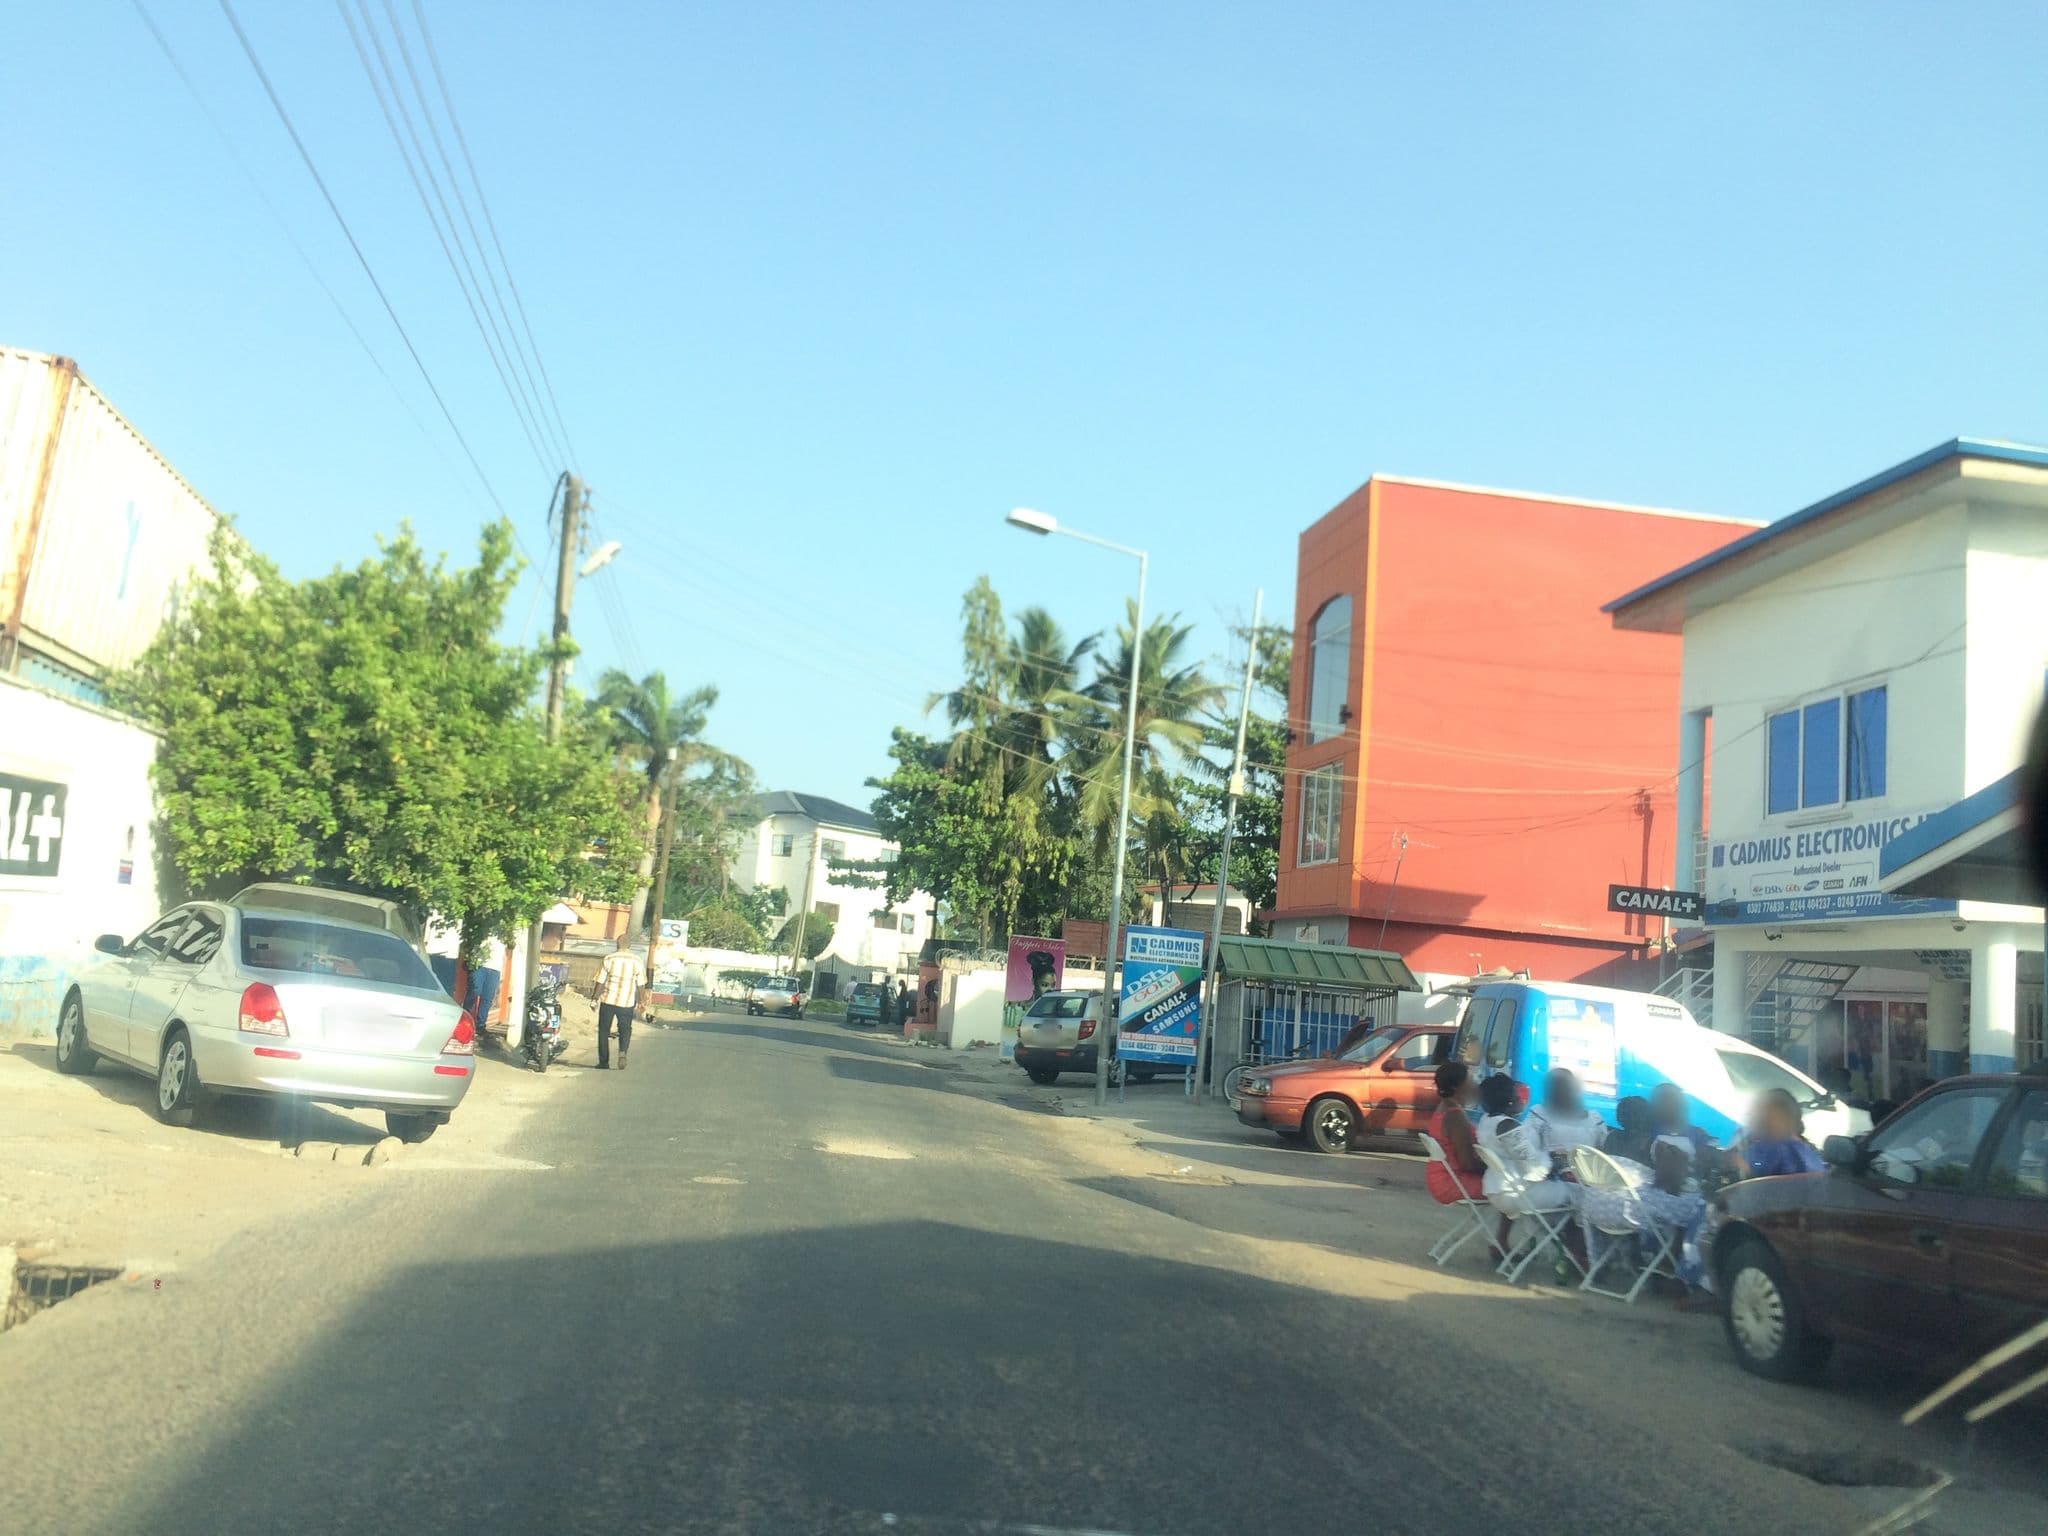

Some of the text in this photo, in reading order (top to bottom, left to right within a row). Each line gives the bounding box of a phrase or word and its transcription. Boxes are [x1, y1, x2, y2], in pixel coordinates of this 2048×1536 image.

[1730, 836, 1791, 866] CADMUS
[1823, 861, 1841, 873] Dealer
[1616, 890, 1697, 913] CANAL+
[1149, 938, 1200, 953] CADMUS
[1149, 950, 1188, 959] ELECTRONICS
[1143, 991, 1188, 1023] CANAL+
[1152, 1001, 1197, 1034] SAMSUNG
